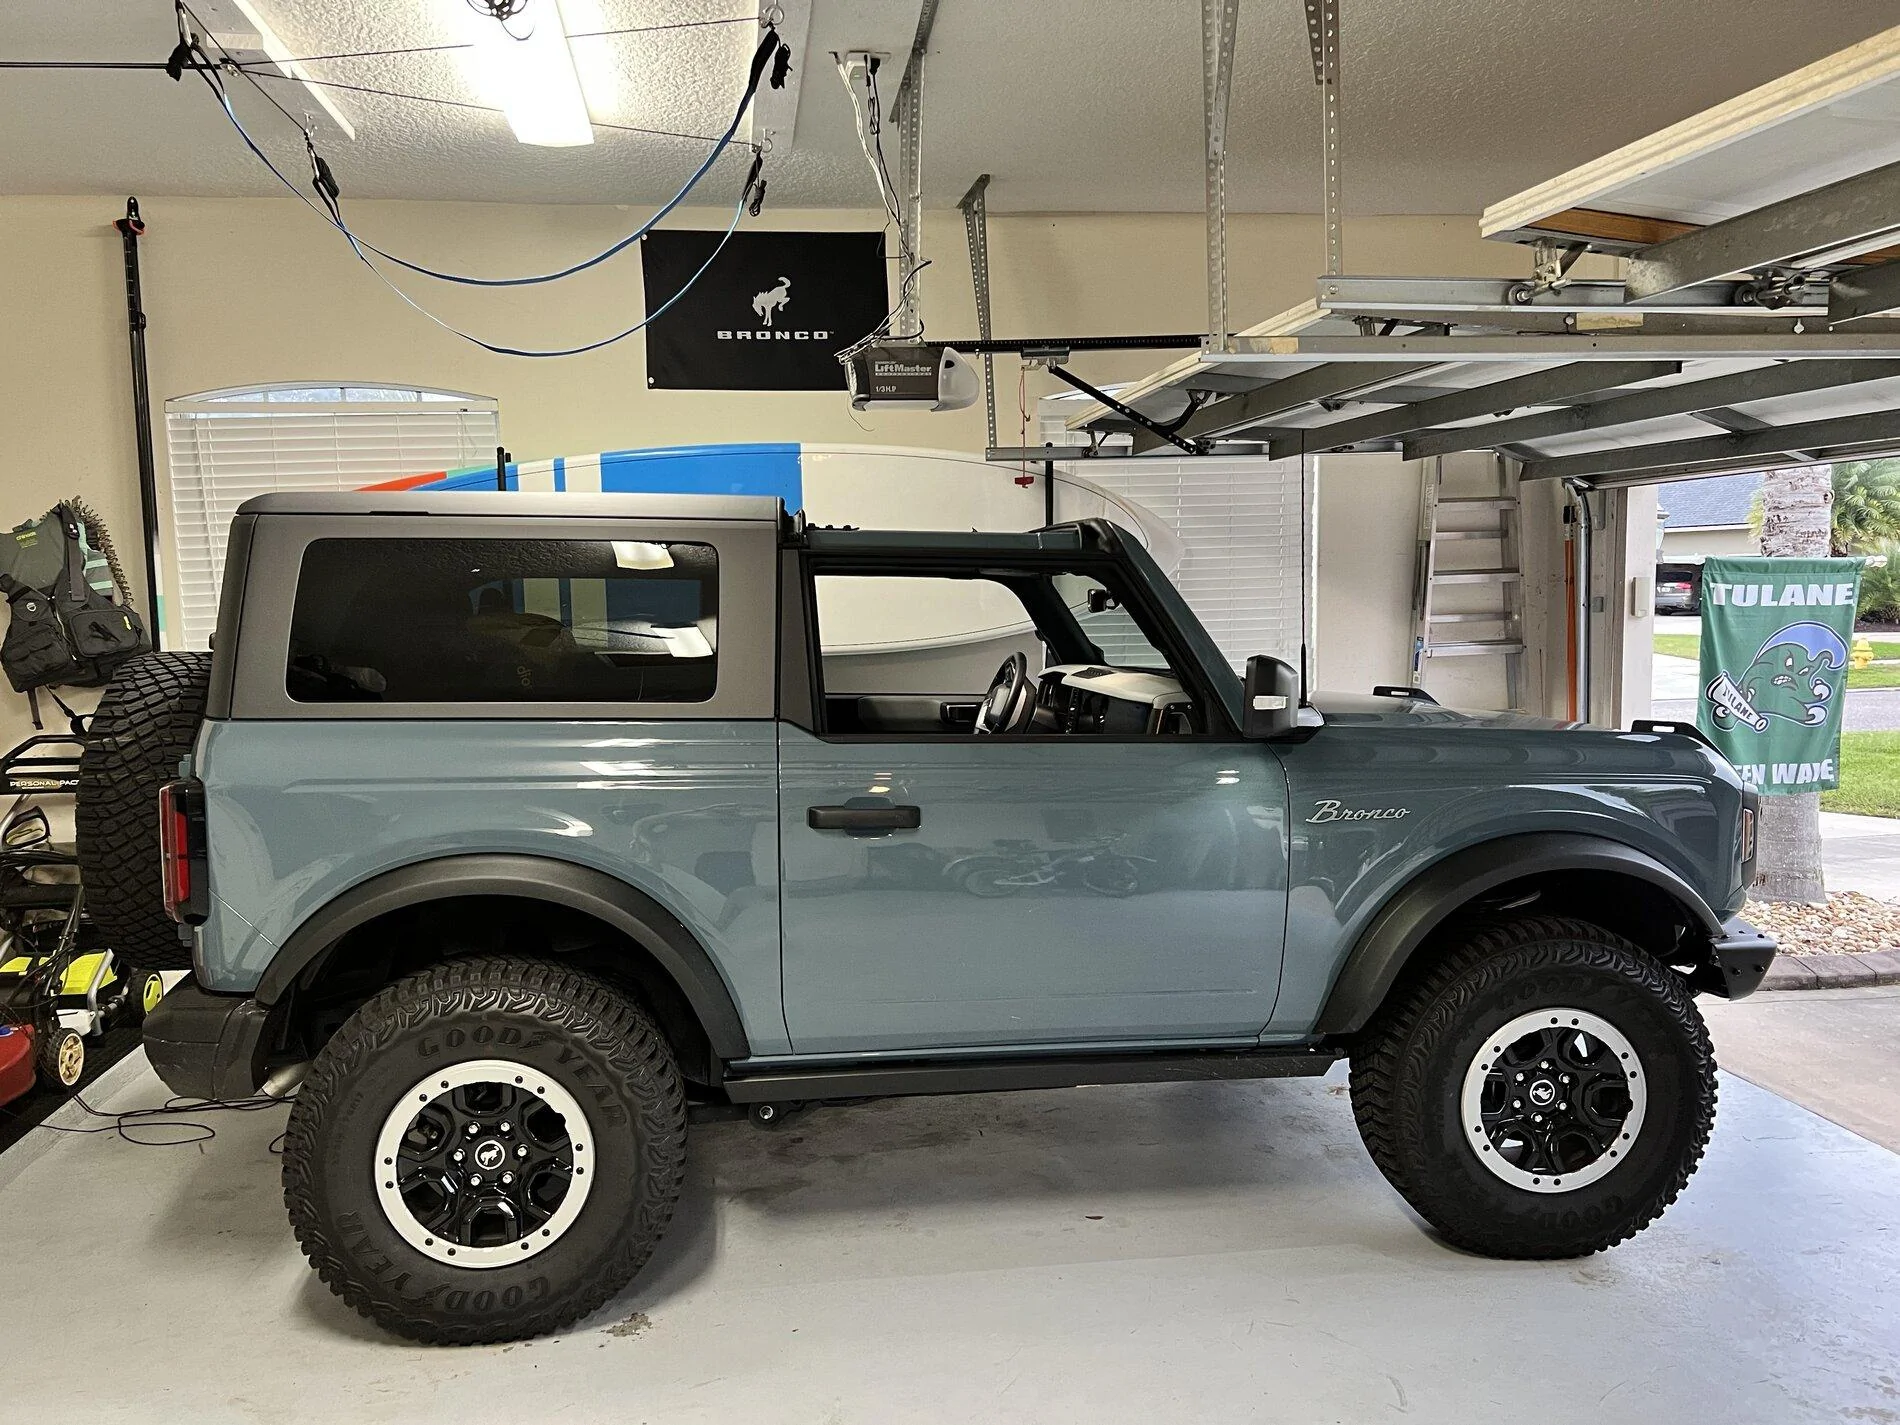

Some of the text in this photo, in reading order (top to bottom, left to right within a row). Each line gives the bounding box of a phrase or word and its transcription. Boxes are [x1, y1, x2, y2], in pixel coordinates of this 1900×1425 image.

[874, 363, 932, 373] LiftMaster
[1710, 582, 1855, 607] TULANE
[1305, 799, 1410, 823] Bronco
